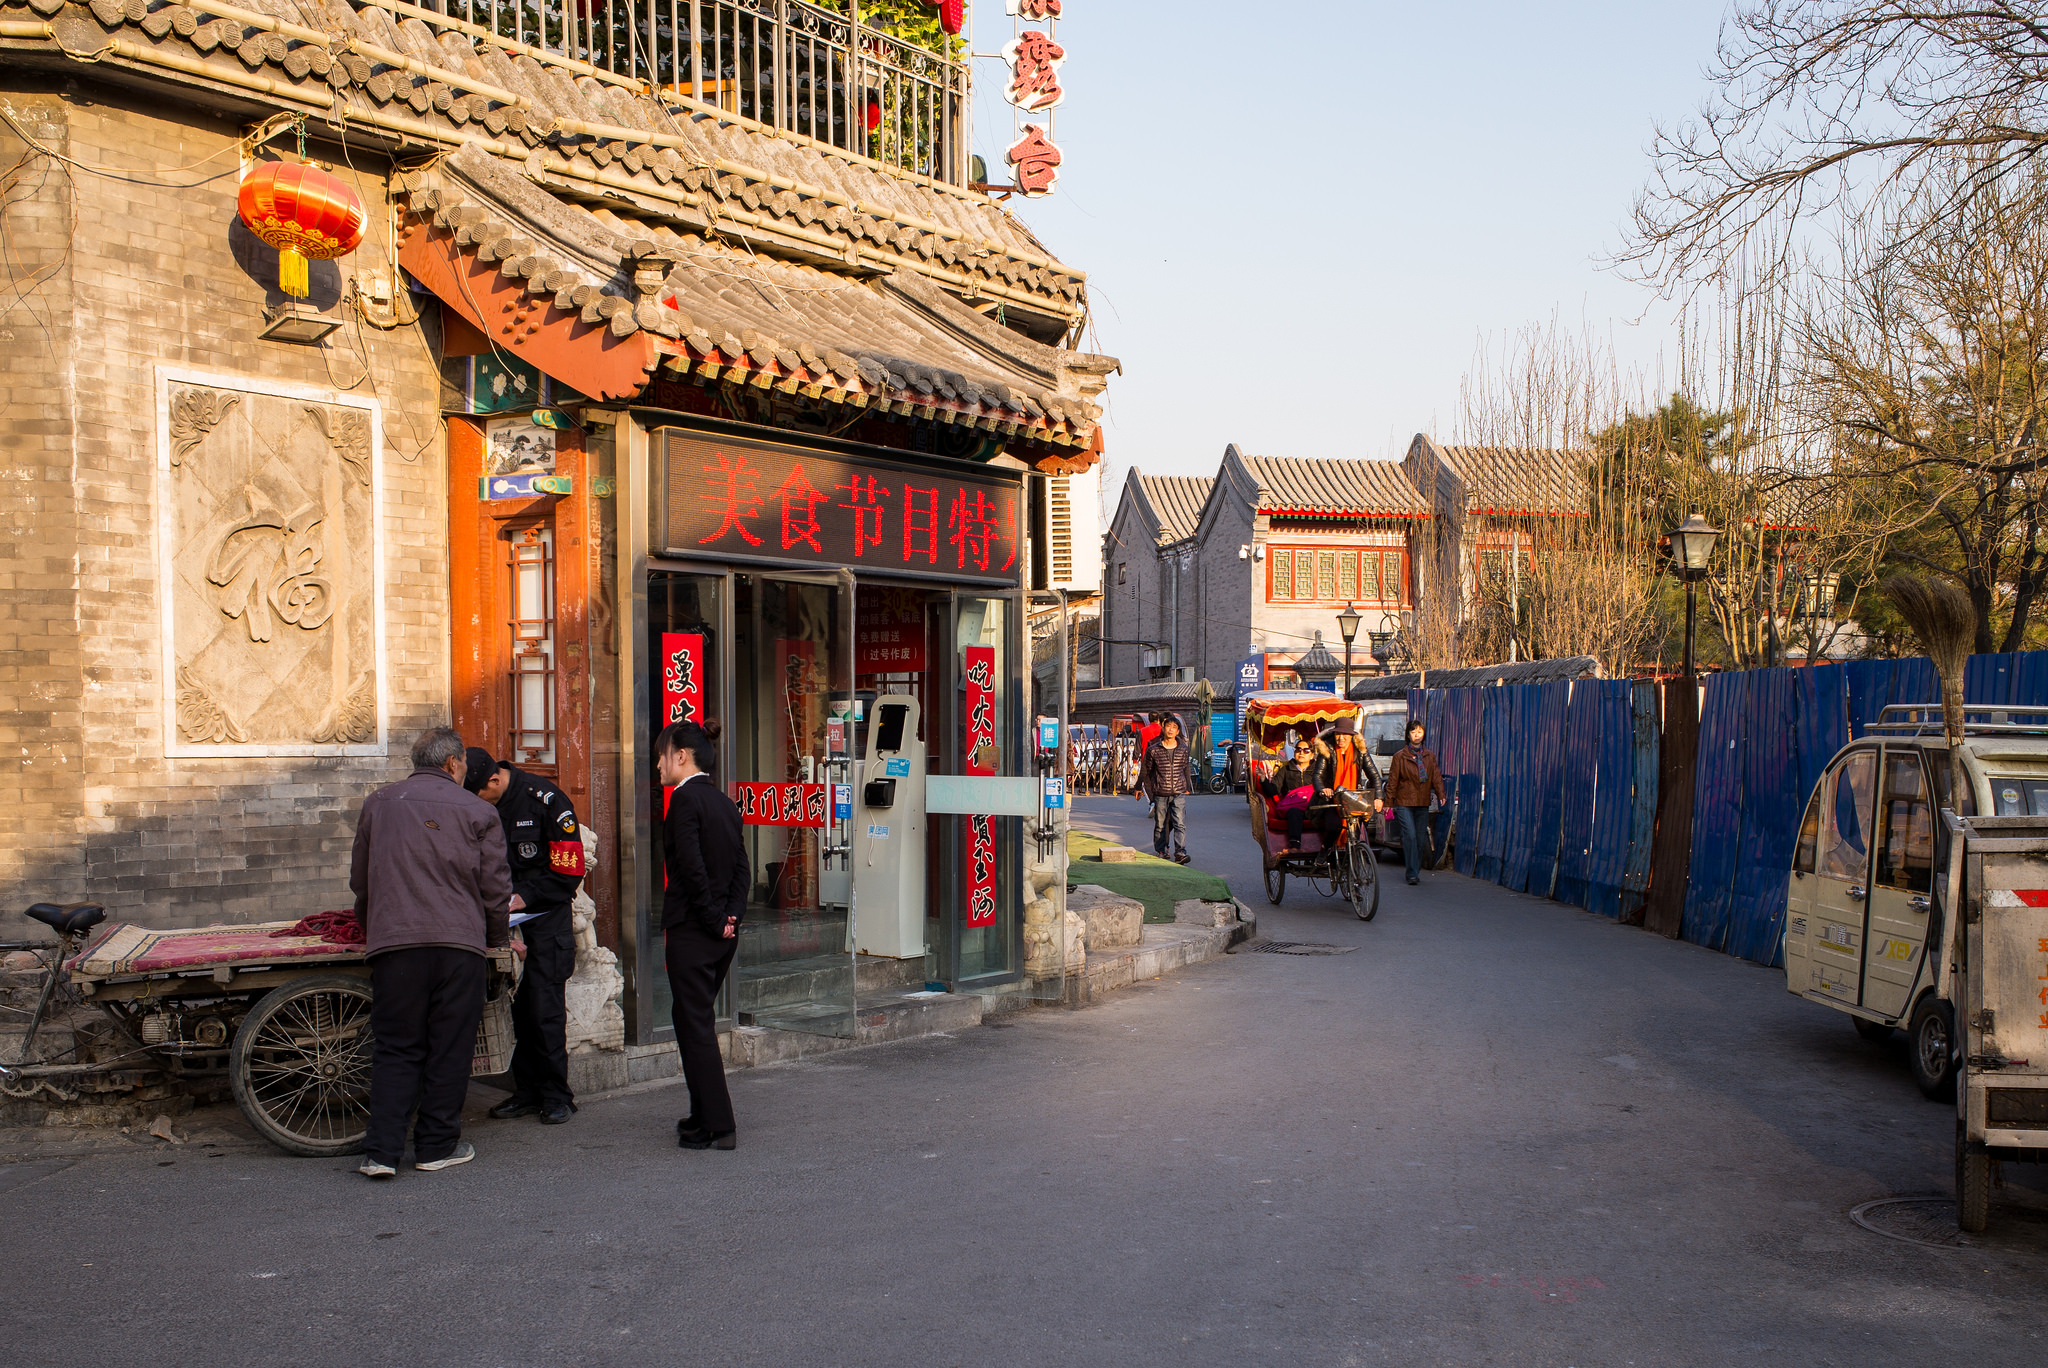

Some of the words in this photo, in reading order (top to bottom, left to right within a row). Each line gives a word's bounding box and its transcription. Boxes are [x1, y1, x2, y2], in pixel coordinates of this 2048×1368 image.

[206, 482, 337, 643] 福
[830, 728, 841, 741] 拉
[1044, 727, 1055, 739] 推
[736, 784, 825, 823] 北门涮肉
